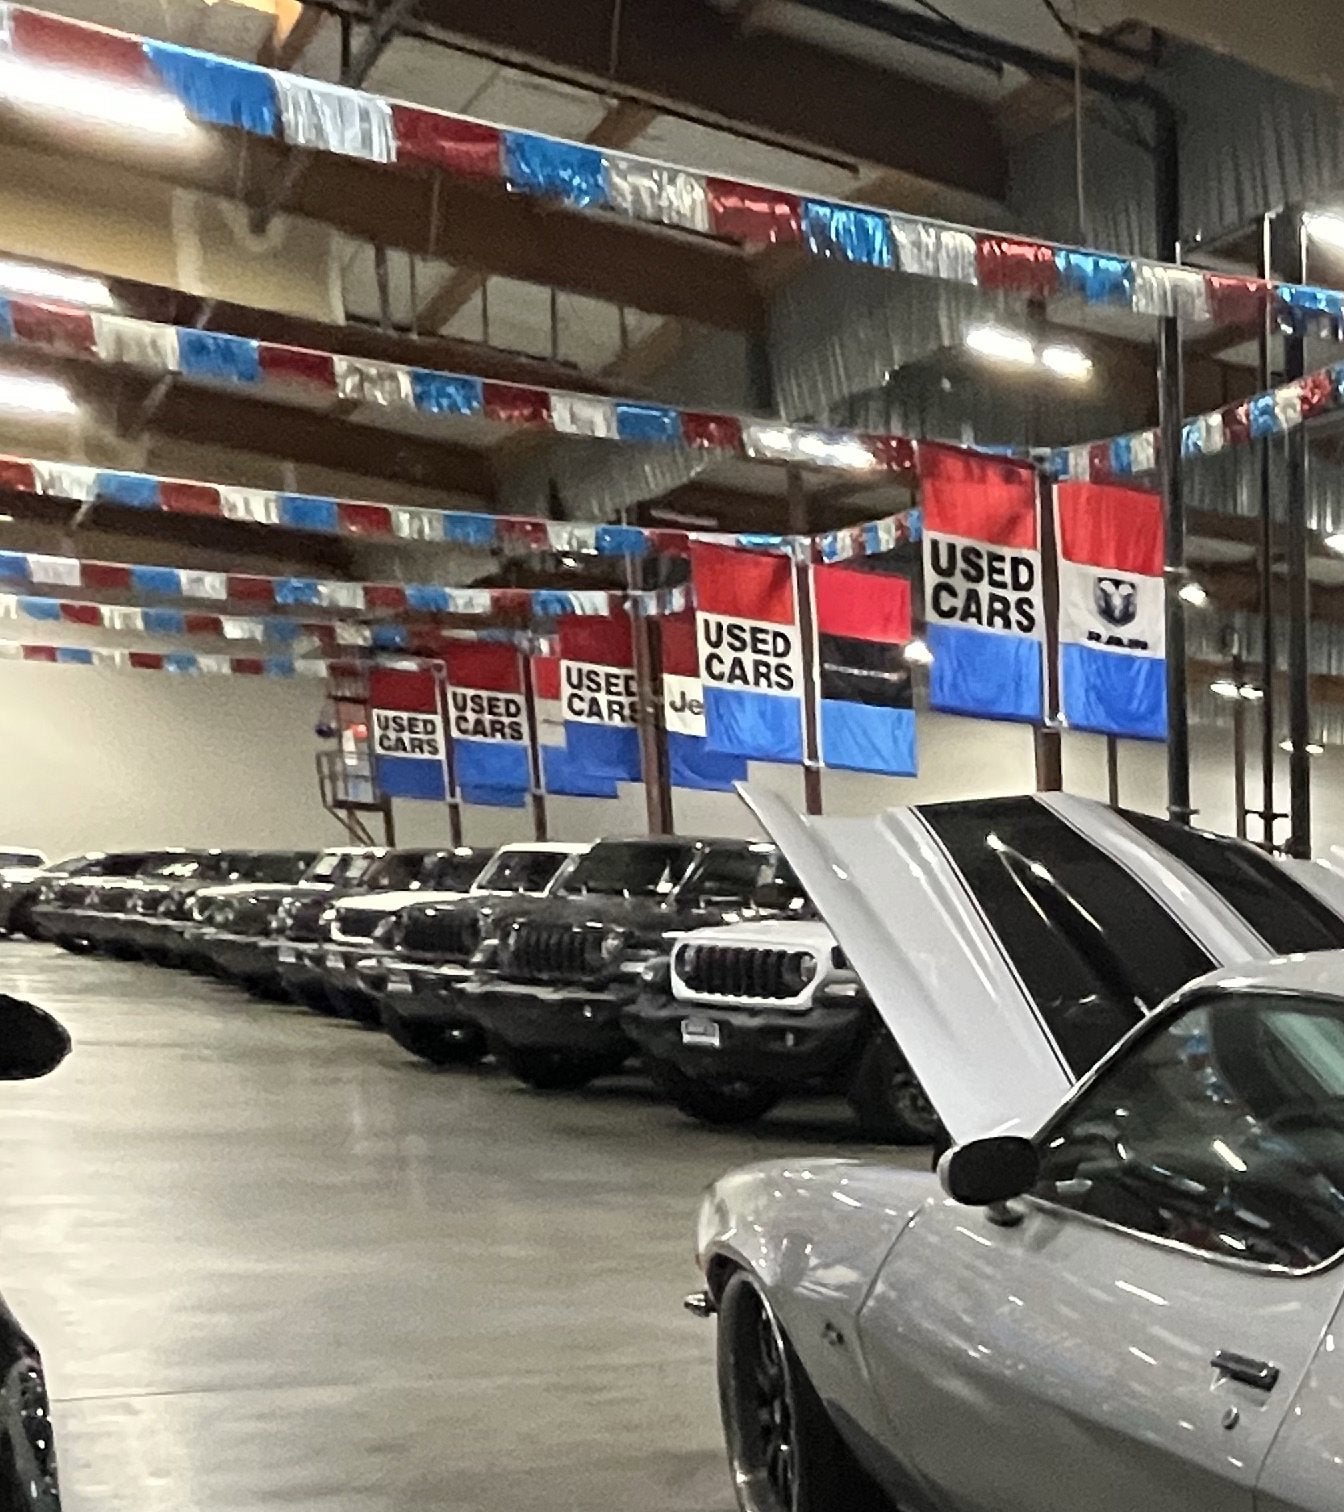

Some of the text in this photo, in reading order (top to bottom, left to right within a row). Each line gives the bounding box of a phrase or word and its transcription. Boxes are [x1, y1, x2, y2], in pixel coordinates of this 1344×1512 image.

[930, 538, 1035, 592] USED
[932, 581, 1036, 633] CARS
[703, 618, 792, 658] USED
[705, 652, 794, 691] CARS
[452, 692, 522, 718] USED
[376, 713, 437, 736] USED
[455, 715, 524, 741] CARS
[379, 734, 440, 756] CARS
